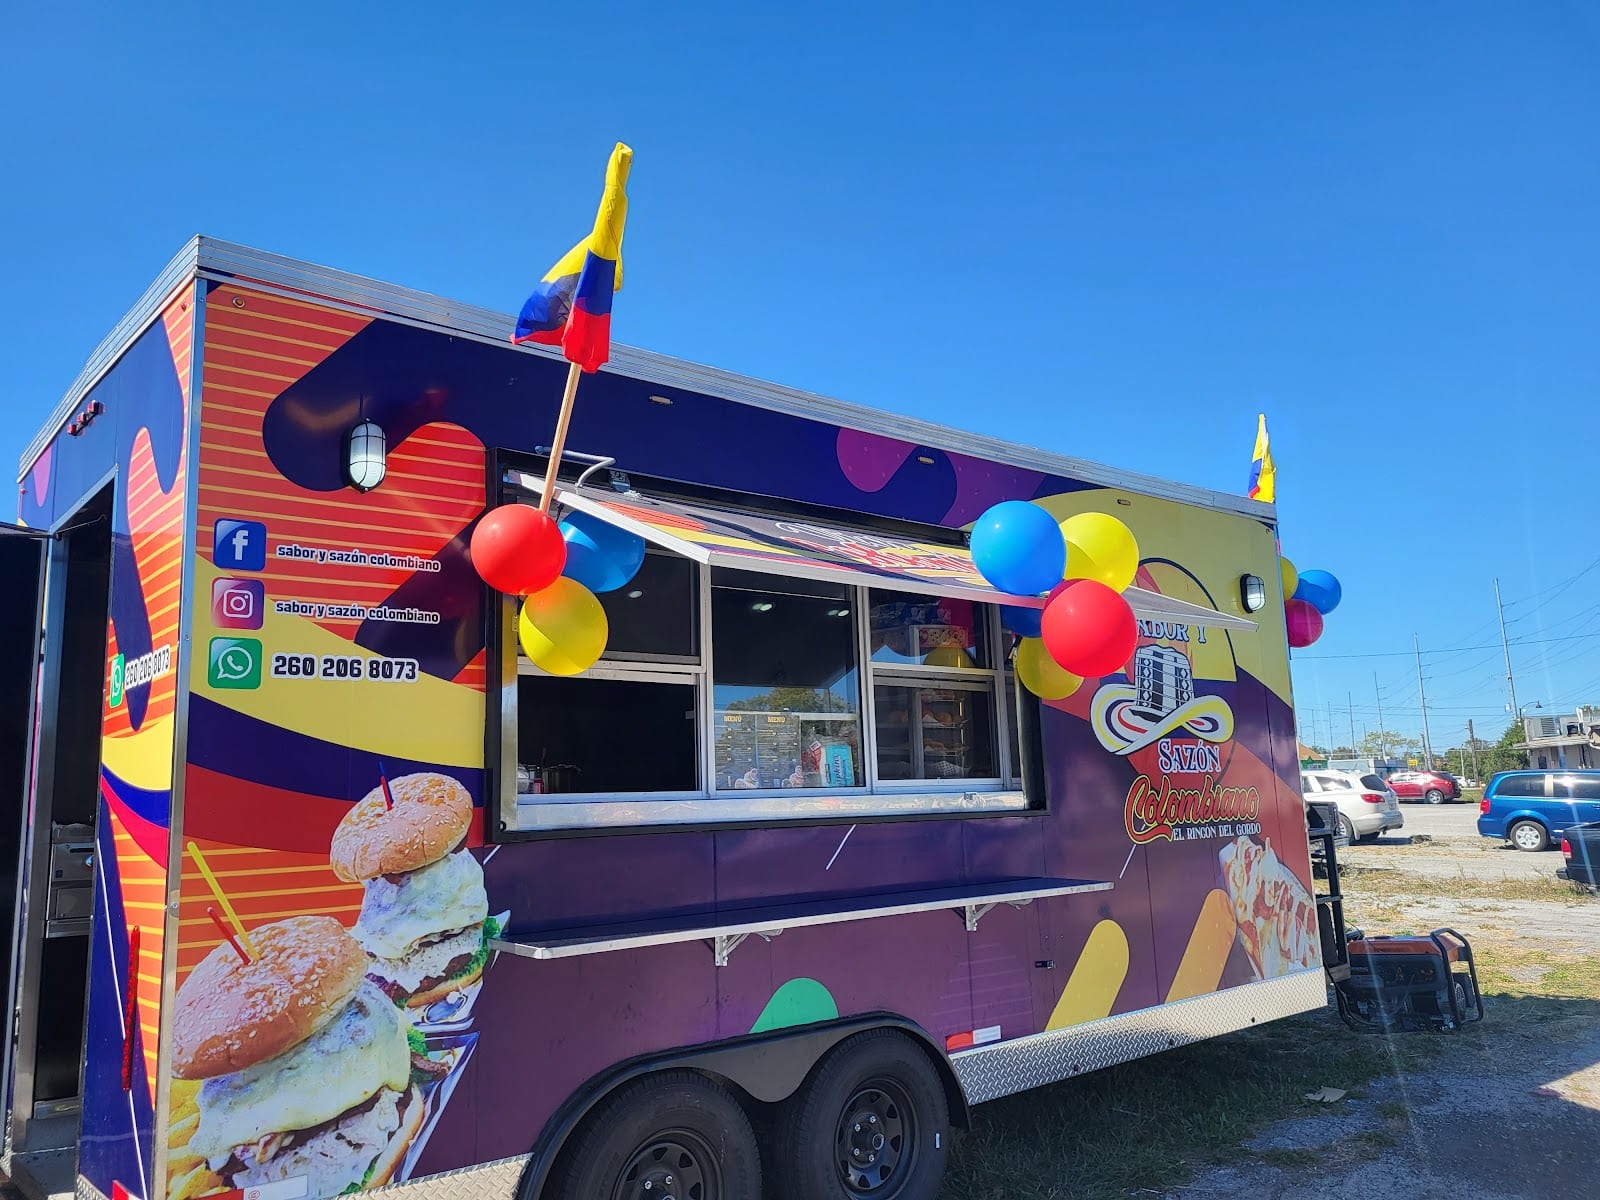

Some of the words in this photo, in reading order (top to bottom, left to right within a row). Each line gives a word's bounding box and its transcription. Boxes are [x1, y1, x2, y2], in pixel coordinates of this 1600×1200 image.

[276, 545, 316, 559] sabor
[318, 550, 327, 562] y
[330, 550, 367, 565] sazón
[370, 555, 441, 571] colombiano
[276, 600, 314, 614] sabor
[317, 605, 326, 617] y
[329, 604, 366, 619] sazón
[368, 608, 440, 623] colombiano
[125, 662, 138, 687] 260
[139, 656, 152, 681] 206
[153, 647, 170, 675] 8073
[273, 655, 316, 677] 260
[321, 657, 362, 679] 206
[368, 660, 417, 680] 8073
[1158, 738, 1221, 773] SAZÓN
[1124, 774, 1260, 844] Colombiano
[1172, 827, 1185, 841] EL
[1186, 824, 1217, 840] RINCÓN
[1218, 824, 1235, 837] DEL
[1236, 822, 1262, 836] GORDO
